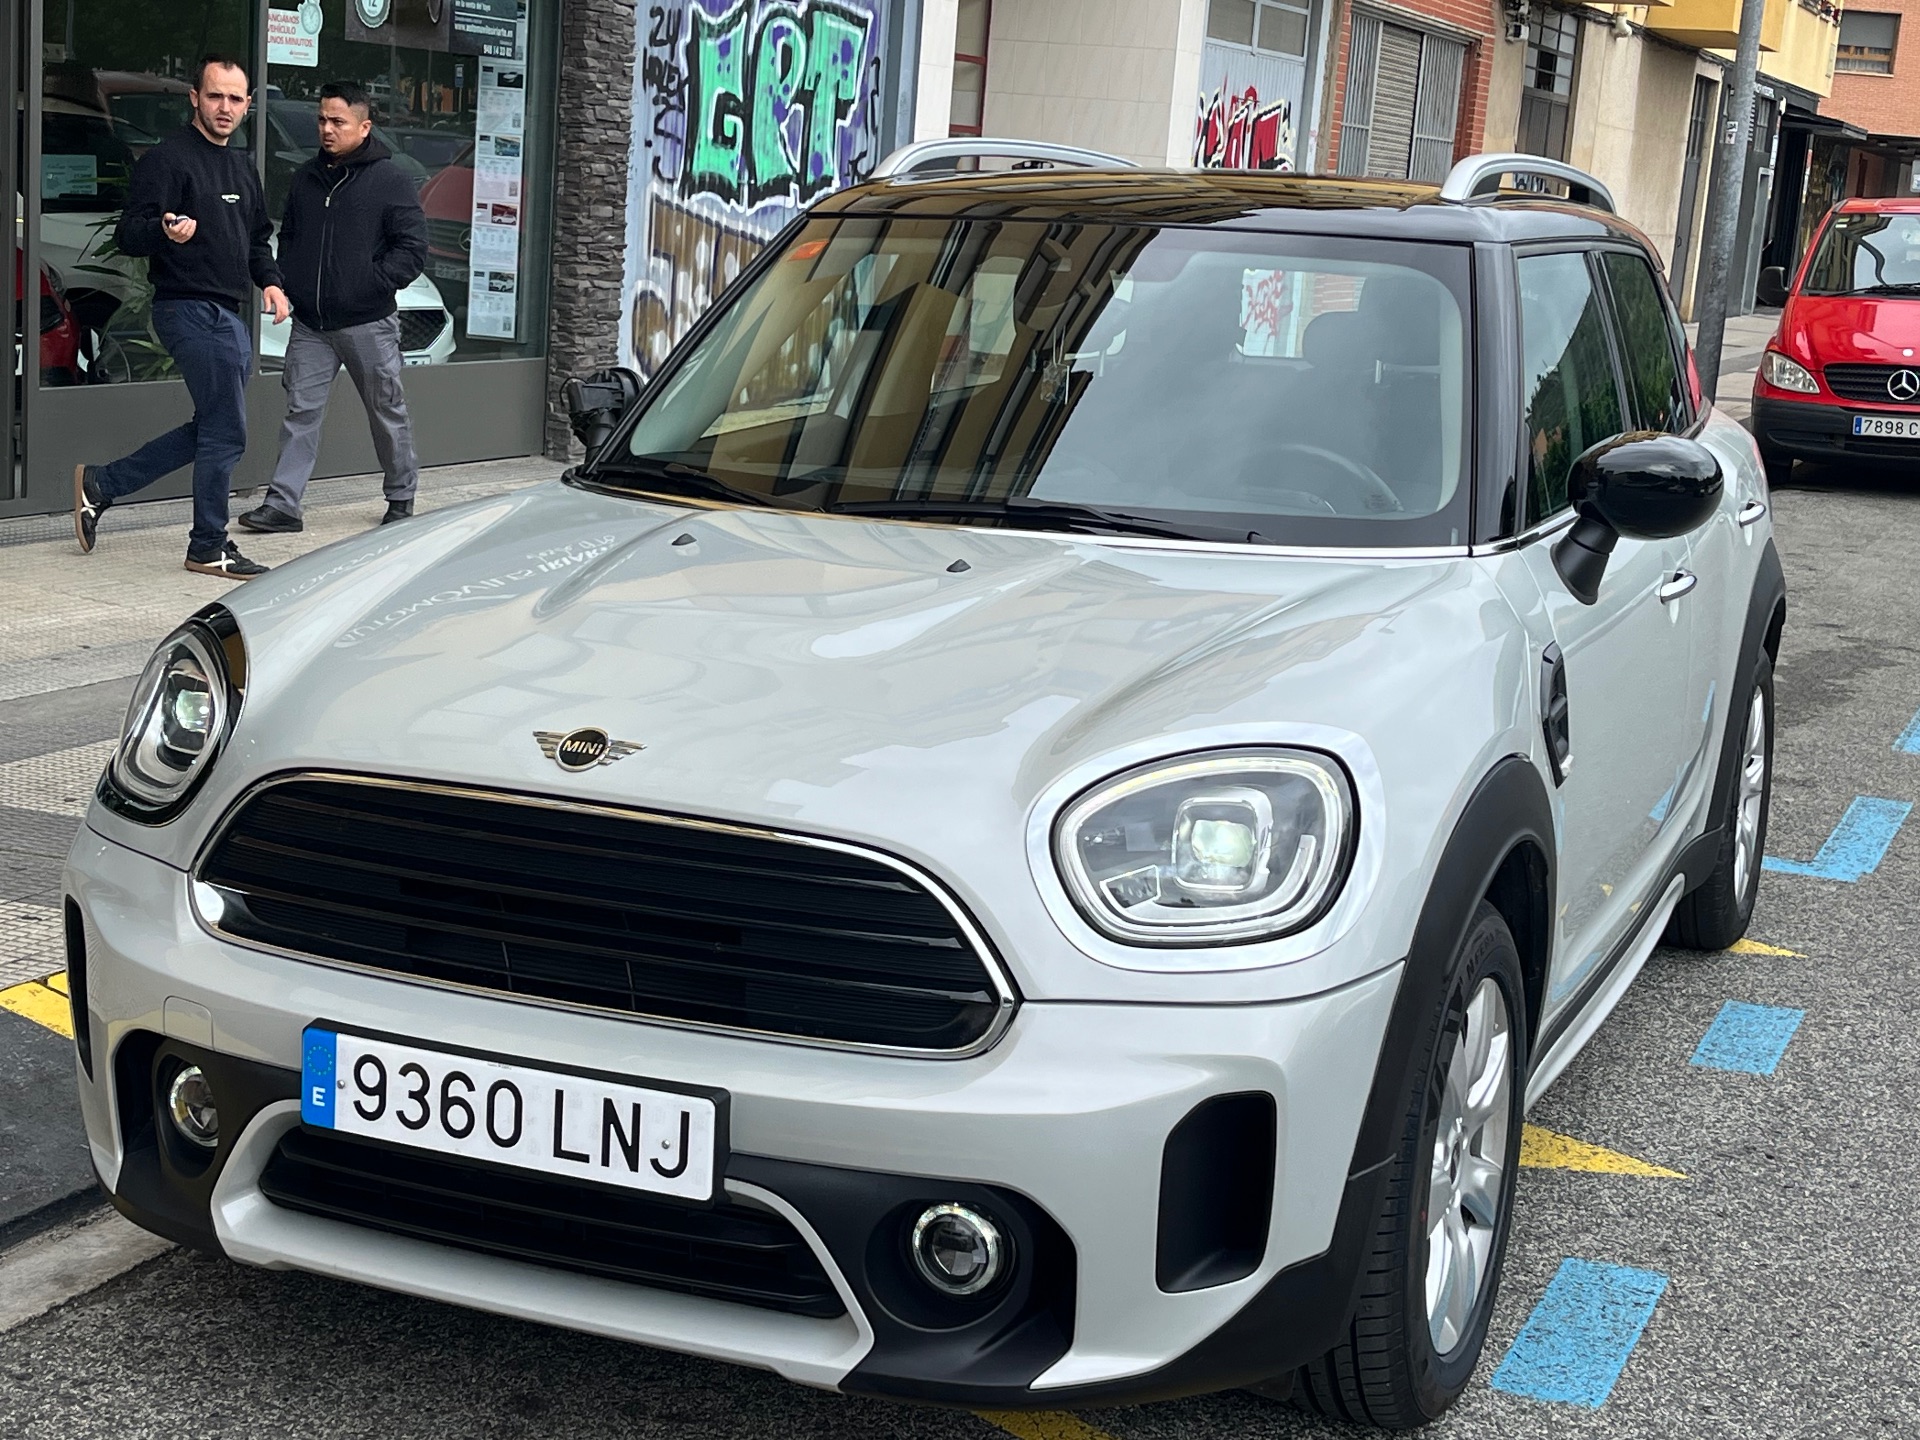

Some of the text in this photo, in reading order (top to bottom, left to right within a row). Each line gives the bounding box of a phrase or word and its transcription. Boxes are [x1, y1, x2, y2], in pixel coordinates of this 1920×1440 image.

[1864, 419, 1904, 435] 7898
[562, 740, 603, 756] MINI
[312, 1086, 326, 1107] E
[353, 1053, 691, 1178] 9360 LNJ
